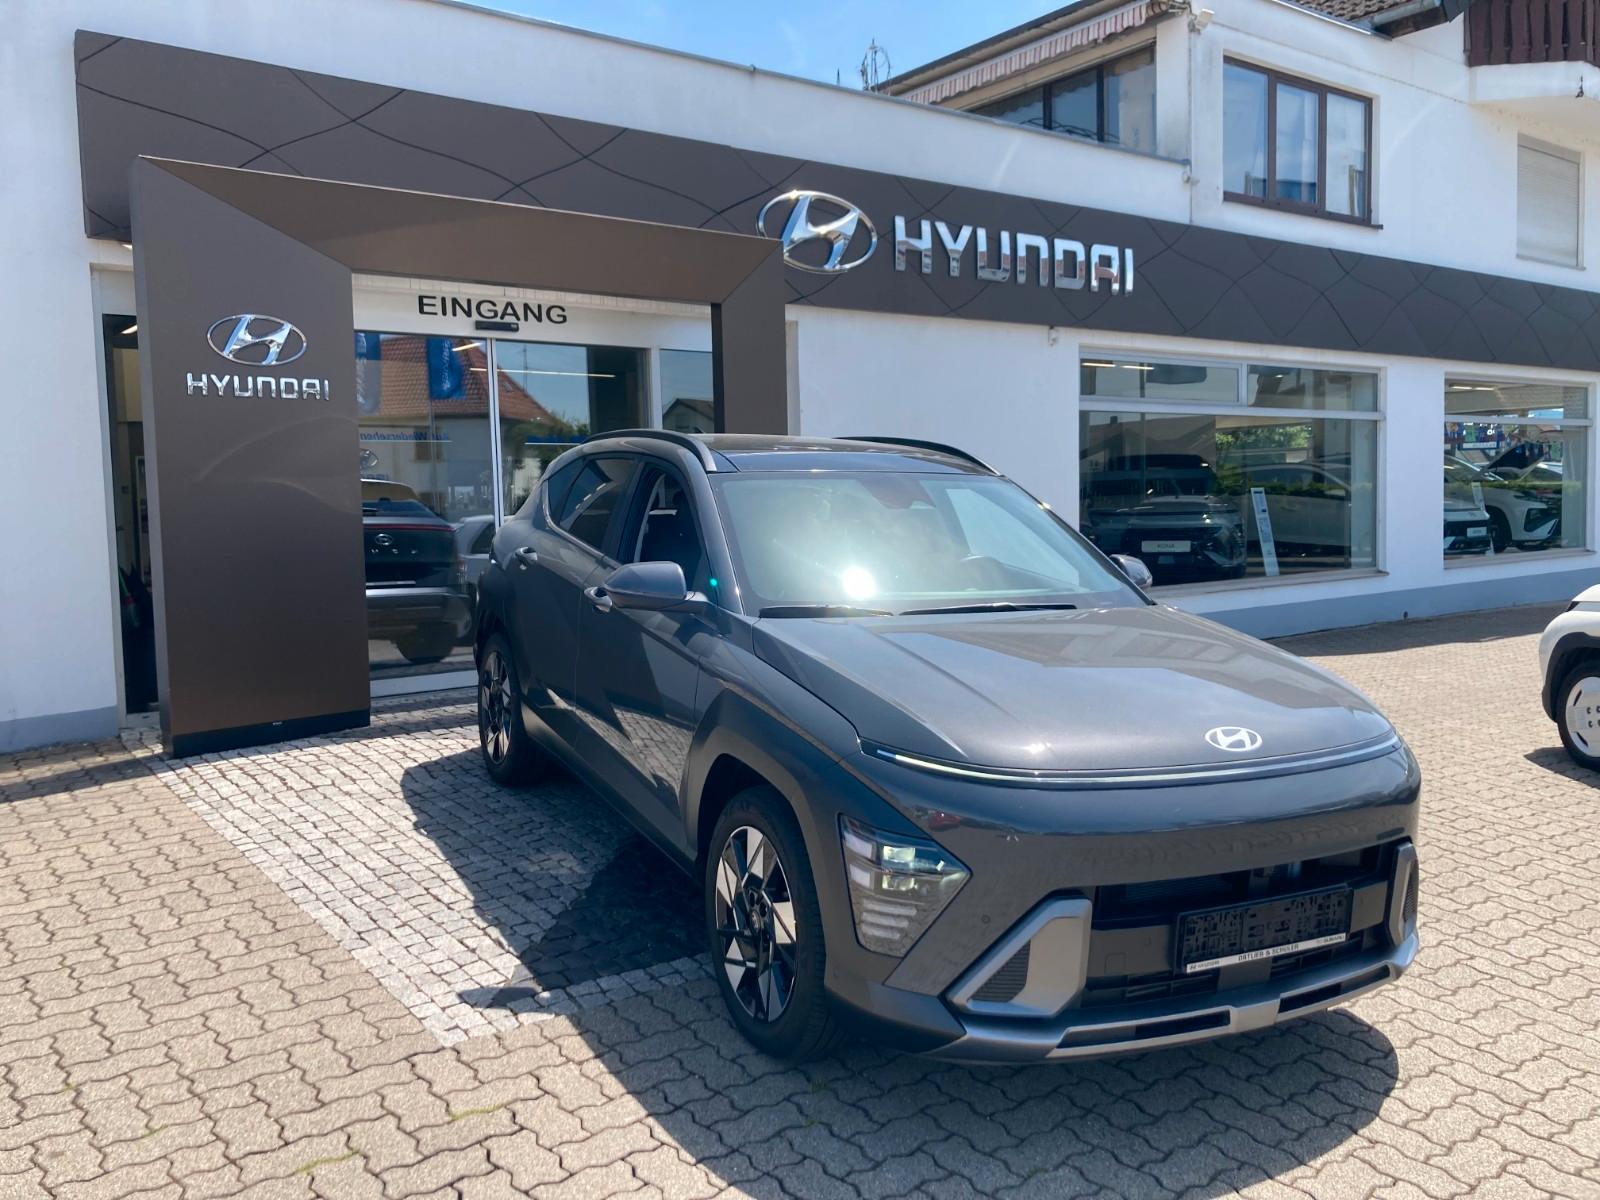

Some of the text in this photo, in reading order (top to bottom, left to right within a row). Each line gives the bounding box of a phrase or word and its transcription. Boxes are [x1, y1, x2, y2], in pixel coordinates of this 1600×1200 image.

[894, 215, 1134, 297] HYUNDAI
[418, 295, 567, 325] EINGANG
[186, 372, 329, 401] HYUNDAI
